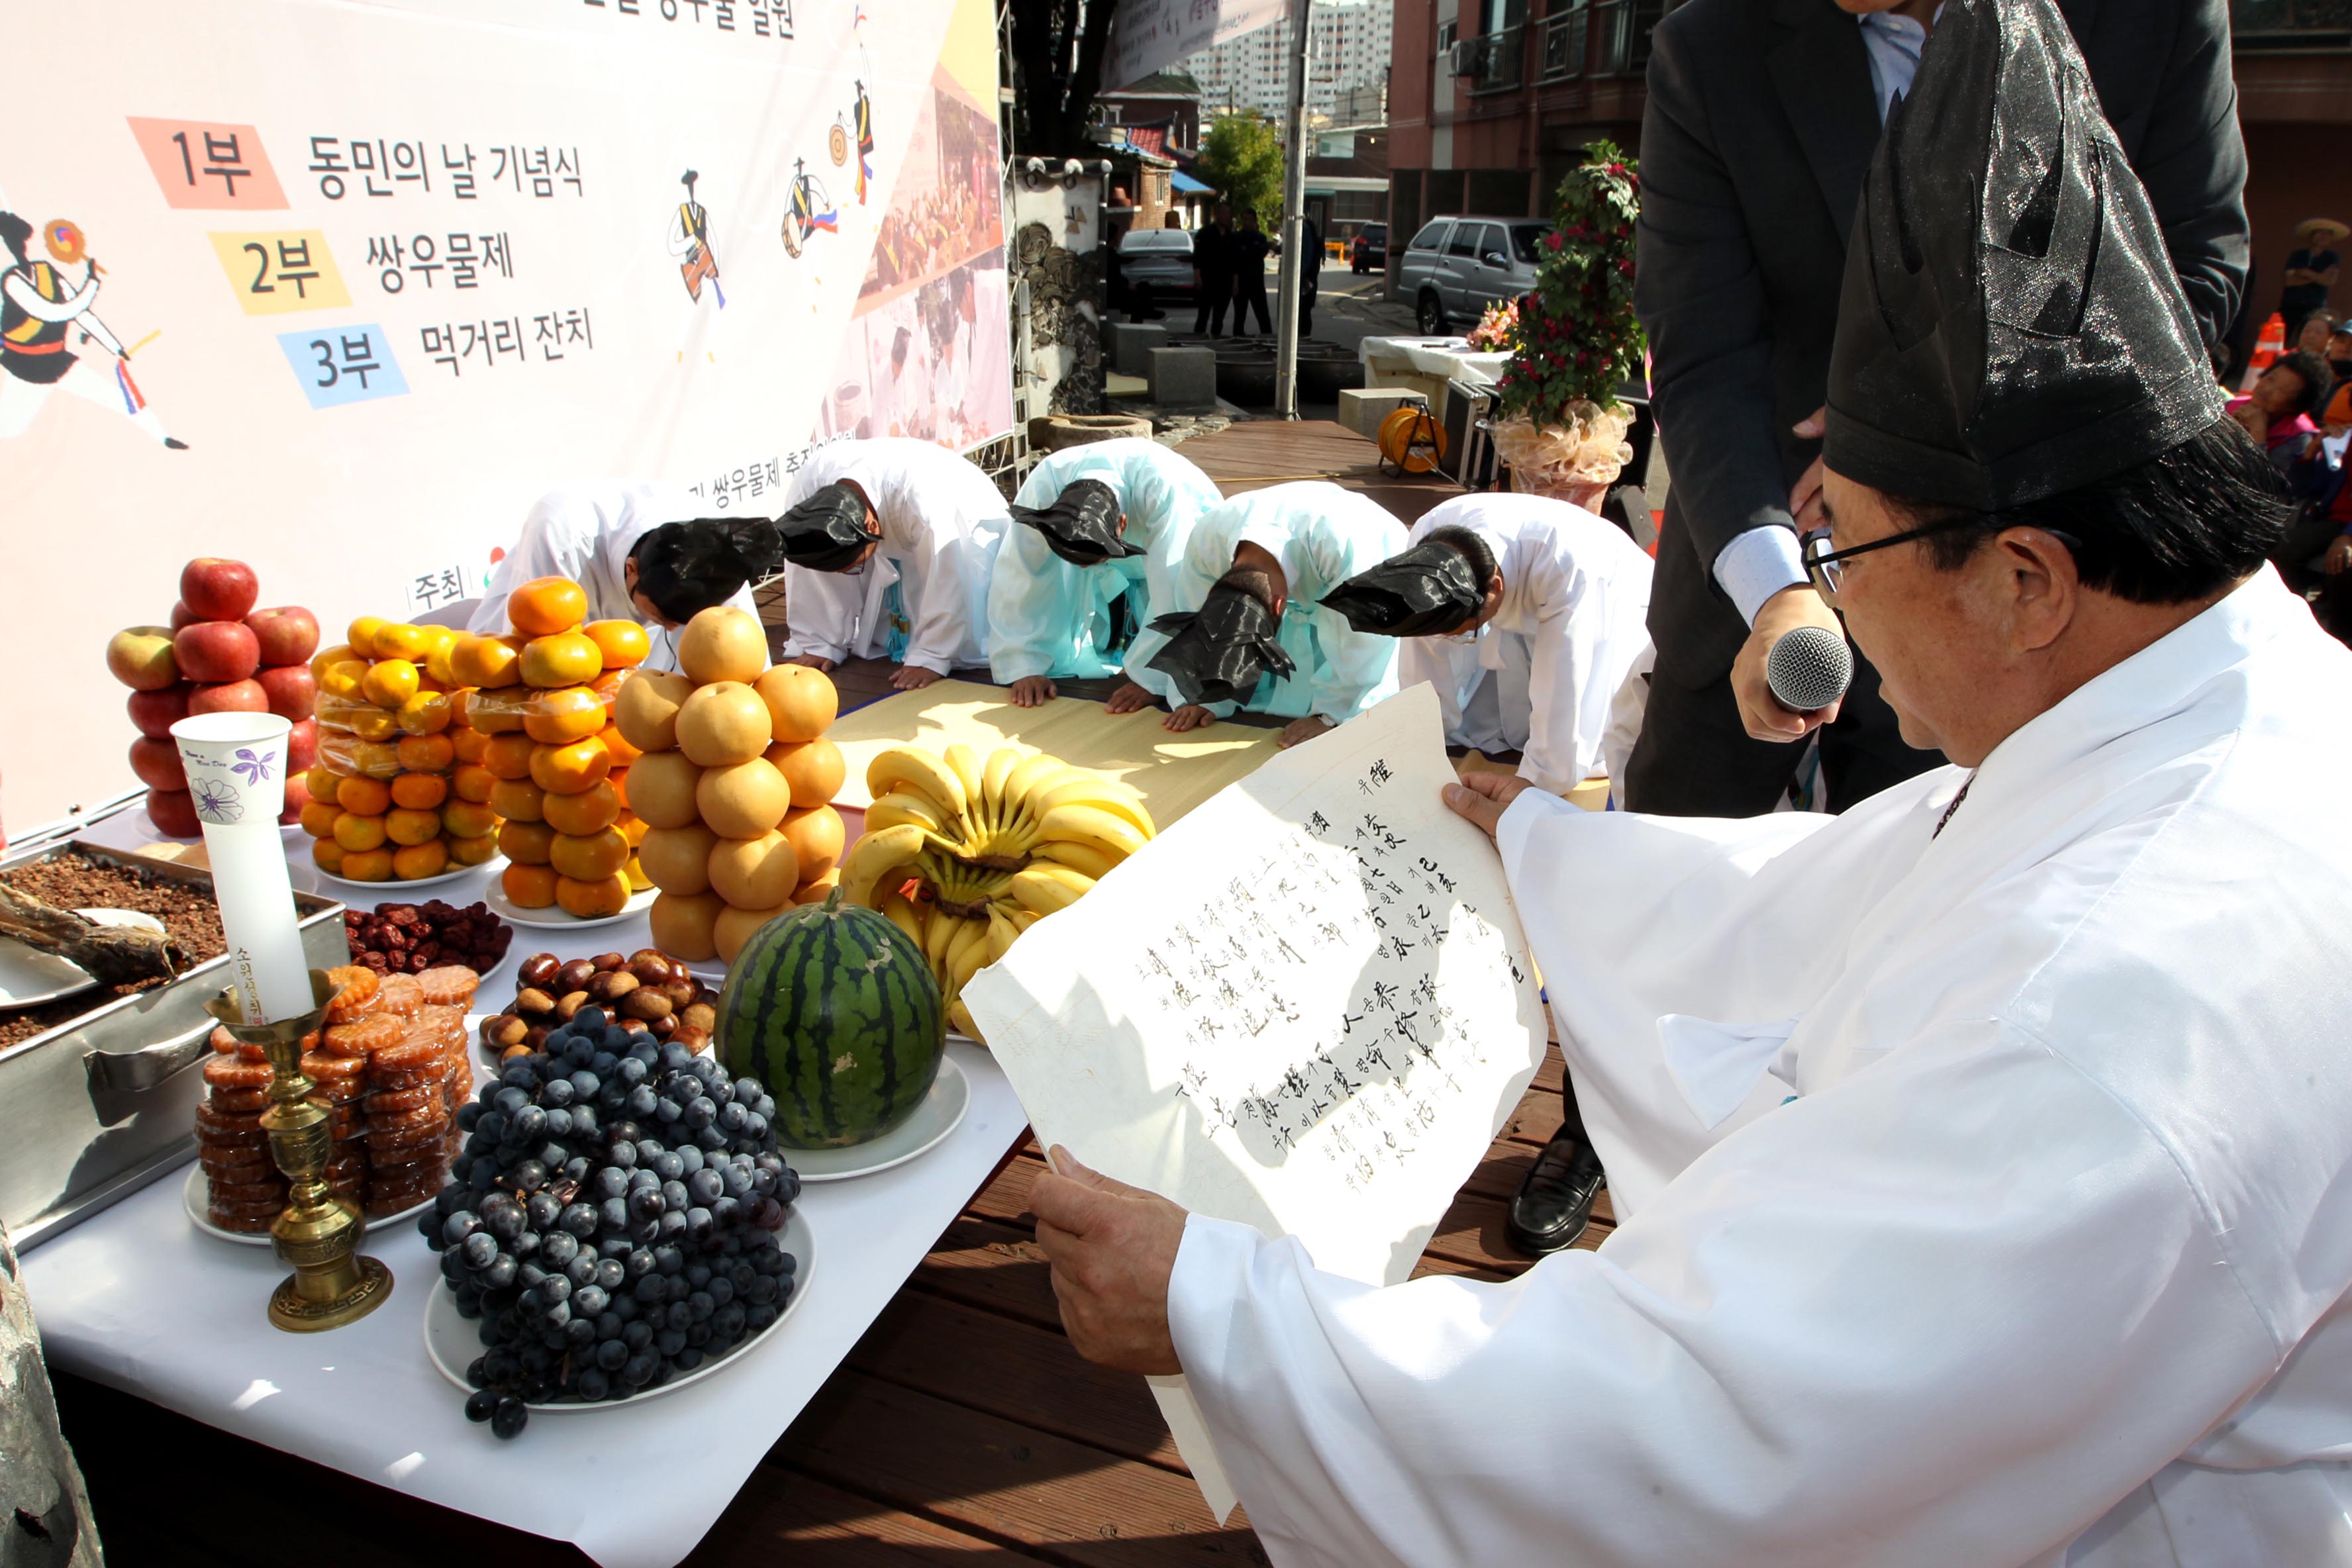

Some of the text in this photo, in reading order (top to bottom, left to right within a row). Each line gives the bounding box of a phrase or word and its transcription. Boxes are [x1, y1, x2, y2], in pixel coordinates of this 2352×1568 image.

[173, 132, 583, 201] 1부 동민의 날 기념식
[244, 232, 513, 299] 2부 쌍우물제
[310, 307, 593, 389] 3부 먹거리 잔치
[415, 565, 464, 610] 주최
[712, 456, 781, 510] 쌍우물제
